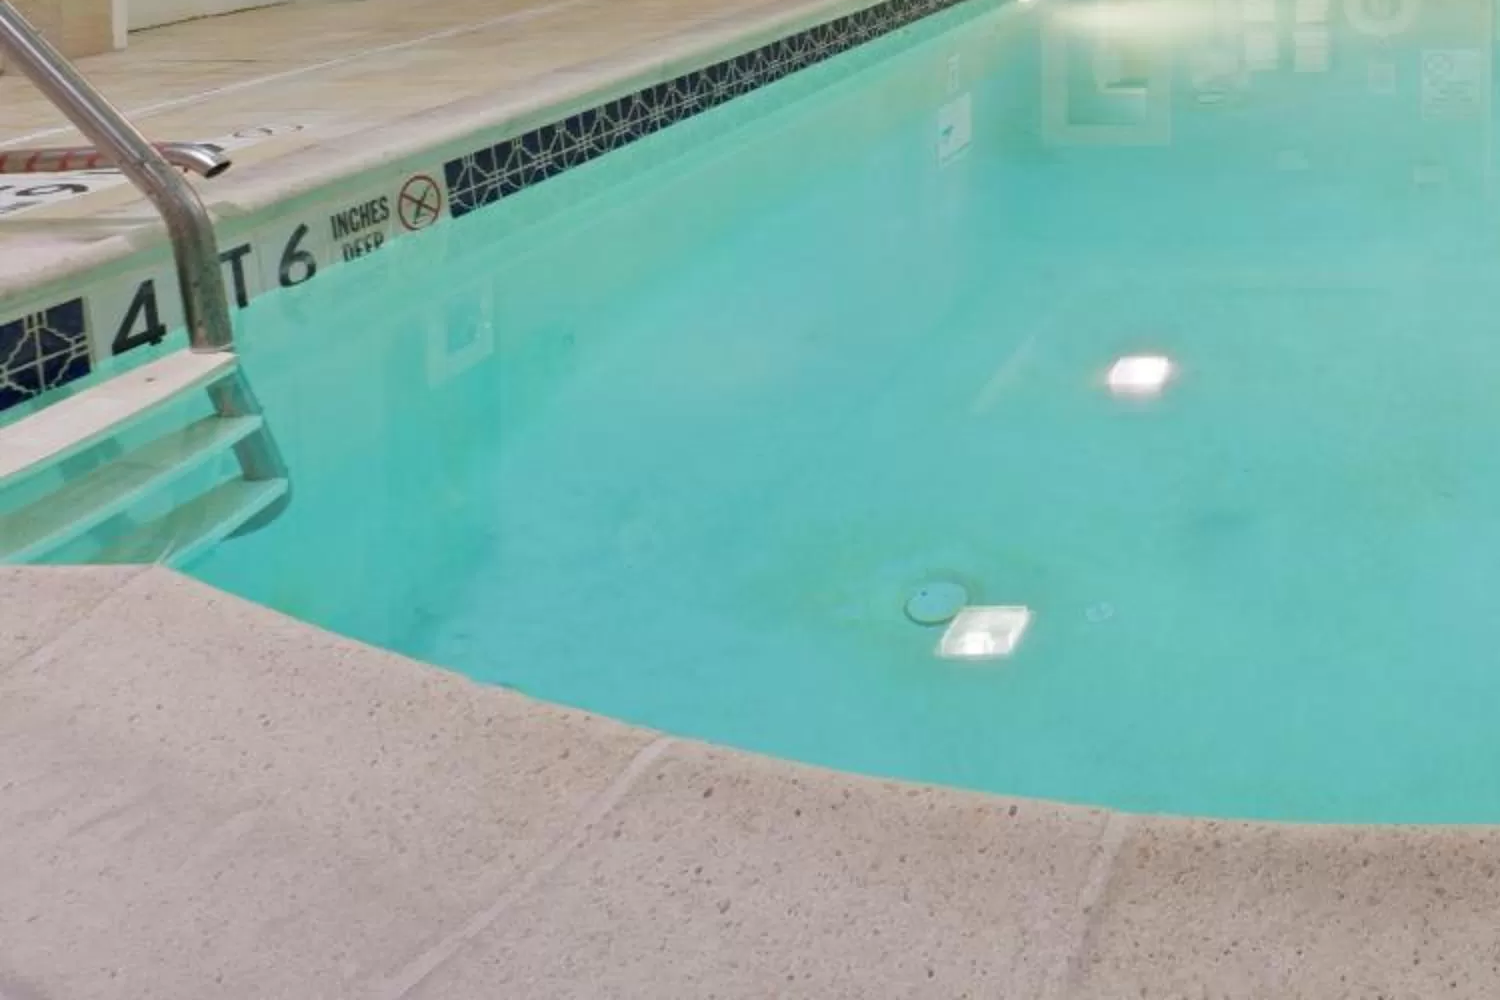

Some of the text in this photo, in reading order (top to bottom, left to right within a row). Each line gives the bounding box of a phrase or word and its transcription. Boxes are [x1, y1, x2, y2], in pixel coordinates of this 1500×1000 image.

[111, 196, 391, 356] 4 T 6 INCHES
[342, 230, 385, 264] DEEP
